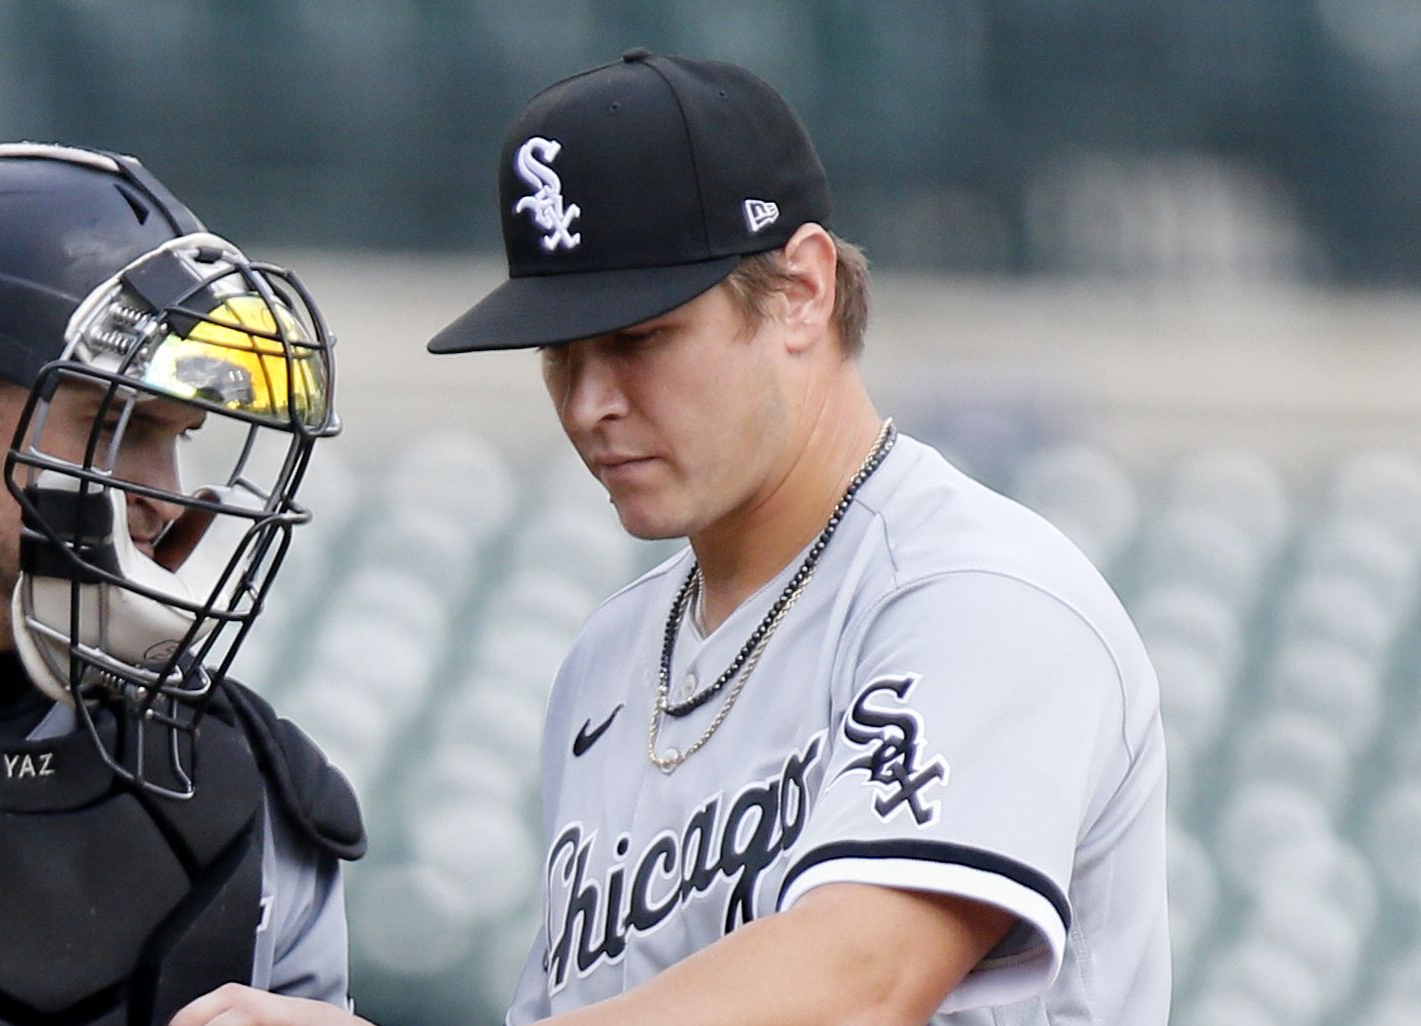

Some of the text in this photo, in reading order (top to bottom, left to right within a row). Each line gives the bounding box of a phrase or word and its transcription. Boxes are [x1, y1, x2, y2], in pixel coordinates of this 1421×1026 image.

[516, 137, 581, 250] Sox
[3, 752, 55, 778] YAZ
[826, 673, 949, 828] Sox
[547, 729, 828, 997] Chicago
